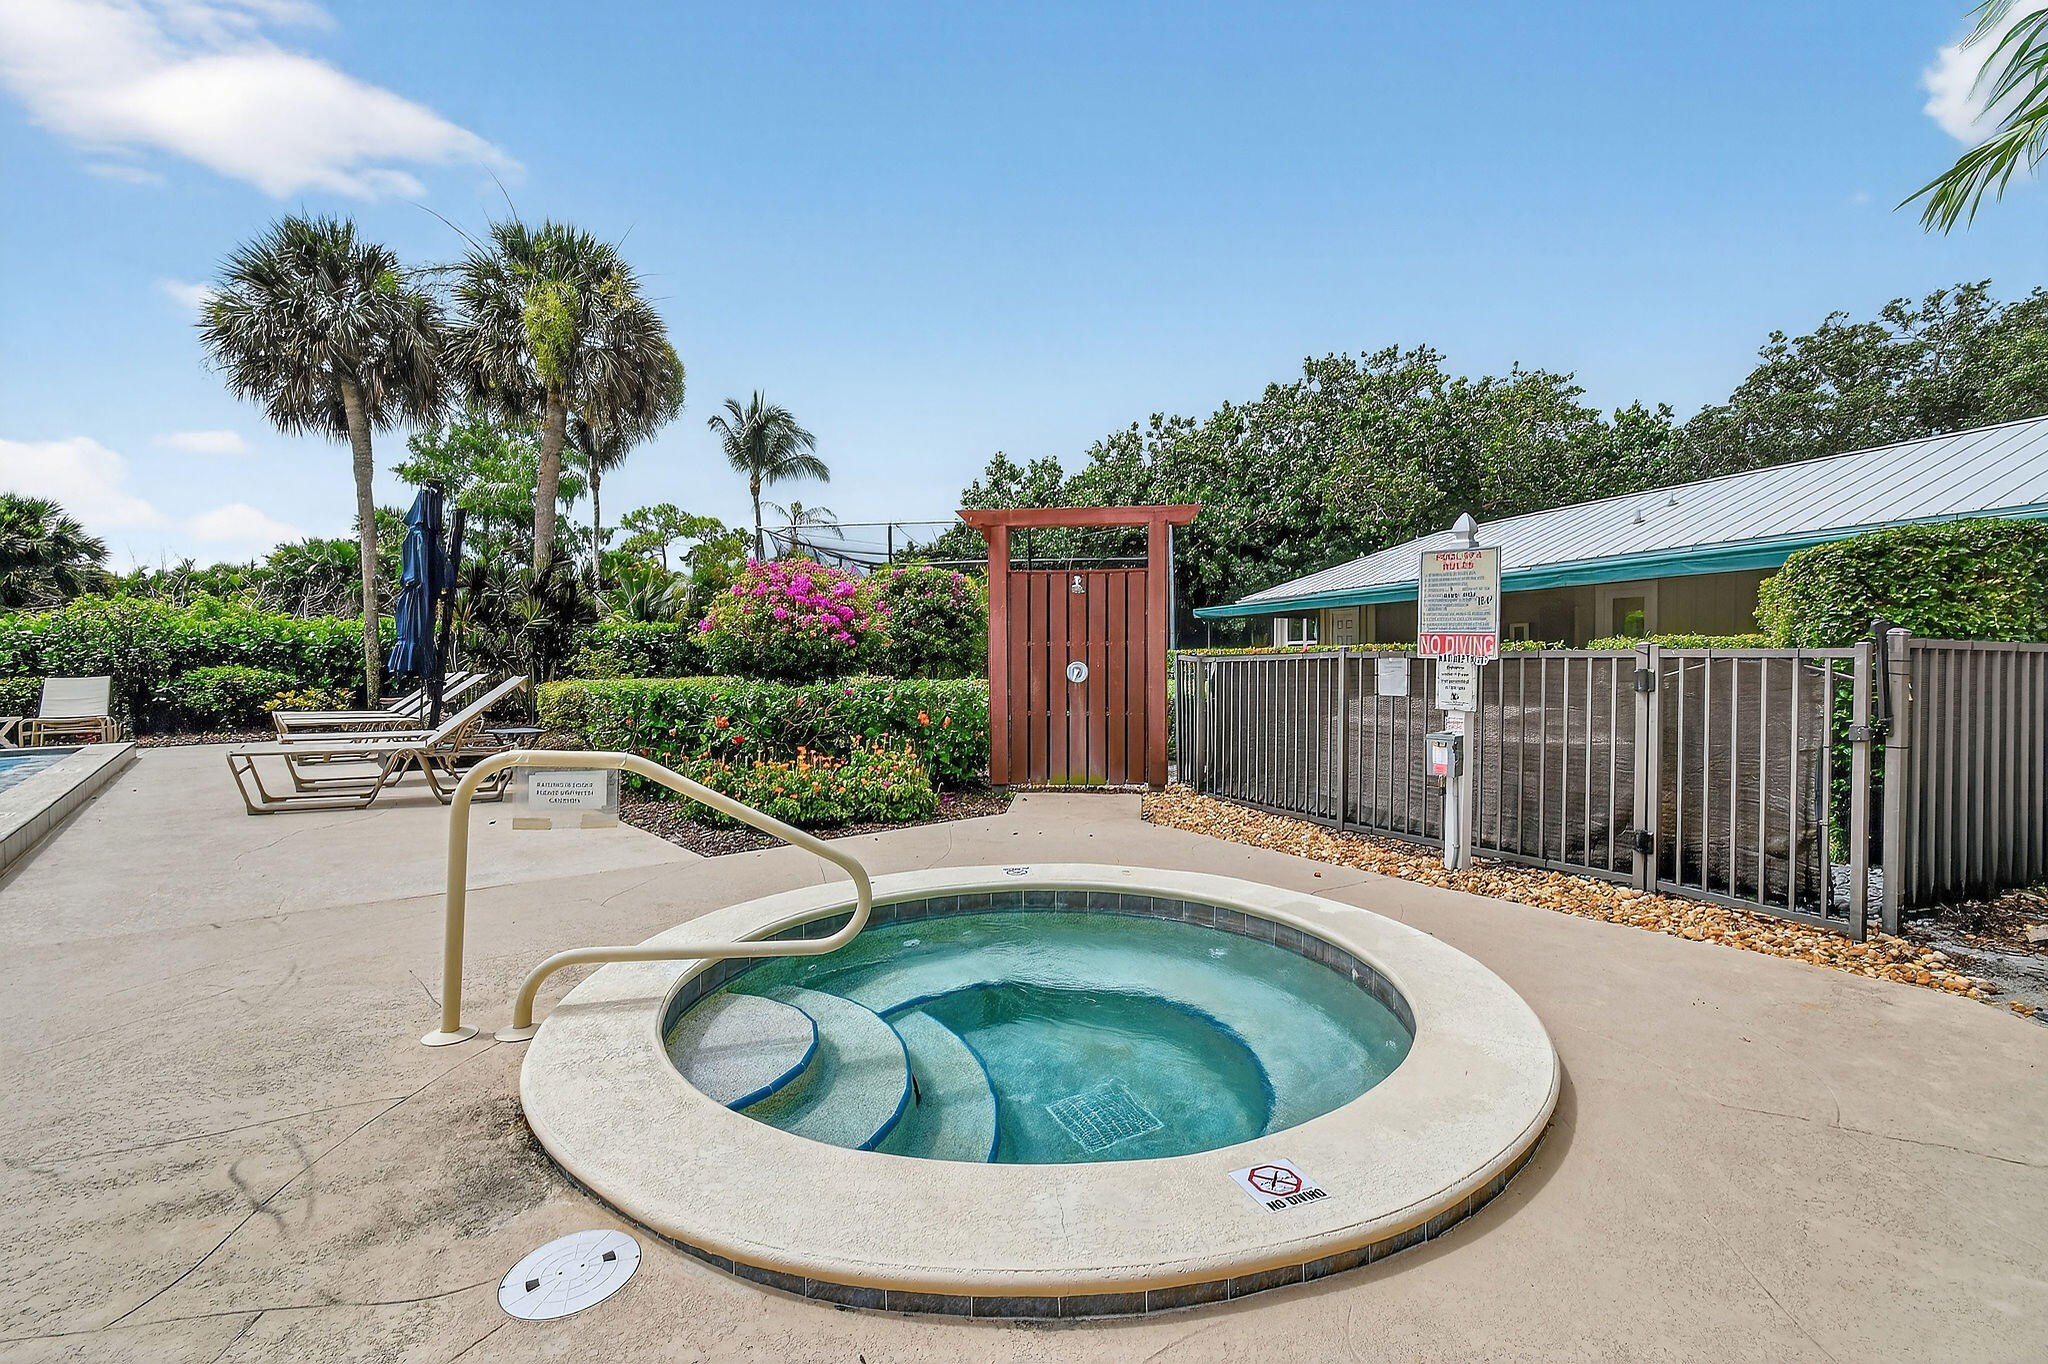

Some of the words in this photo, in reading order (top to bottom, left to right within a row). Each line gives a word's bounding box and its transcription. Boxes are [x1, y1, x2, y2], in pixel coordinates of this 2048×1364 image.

[1420, 635, 1441, 654] NO
[1445, 635, 1495, 656] DIVING
[1265, 1199, 1286, 1211] NO
